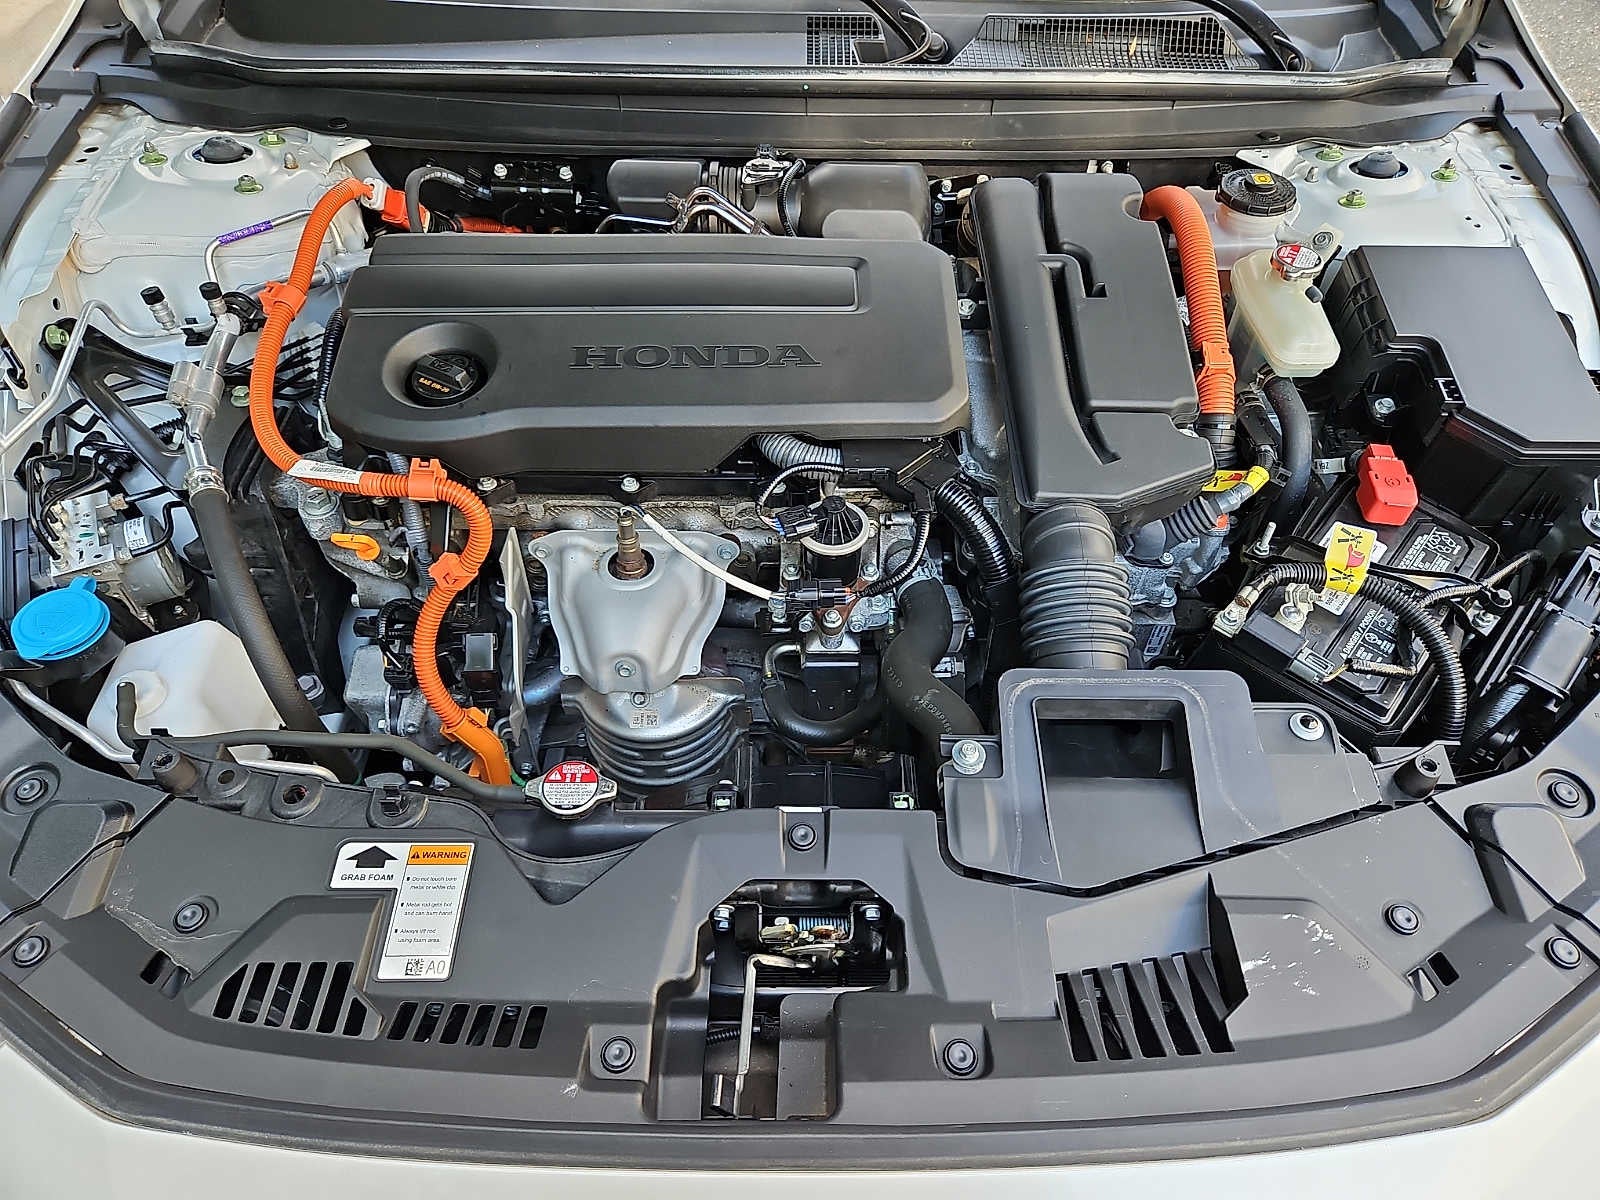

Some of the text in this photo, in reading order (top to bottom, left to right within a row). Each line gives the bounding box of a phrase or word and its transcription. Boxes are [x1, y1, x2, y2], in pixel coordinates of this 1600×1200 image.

[569, 344, 822, 369] HONDA
[418, 377, 432, 386] SAE
[1342, 630, 1361, 655] DANGER
[1360, 608, 1378, 629] POISON
[421, 851, 467, 859] WARNING
[340, 873, 394, 881] GRAB FOAM
